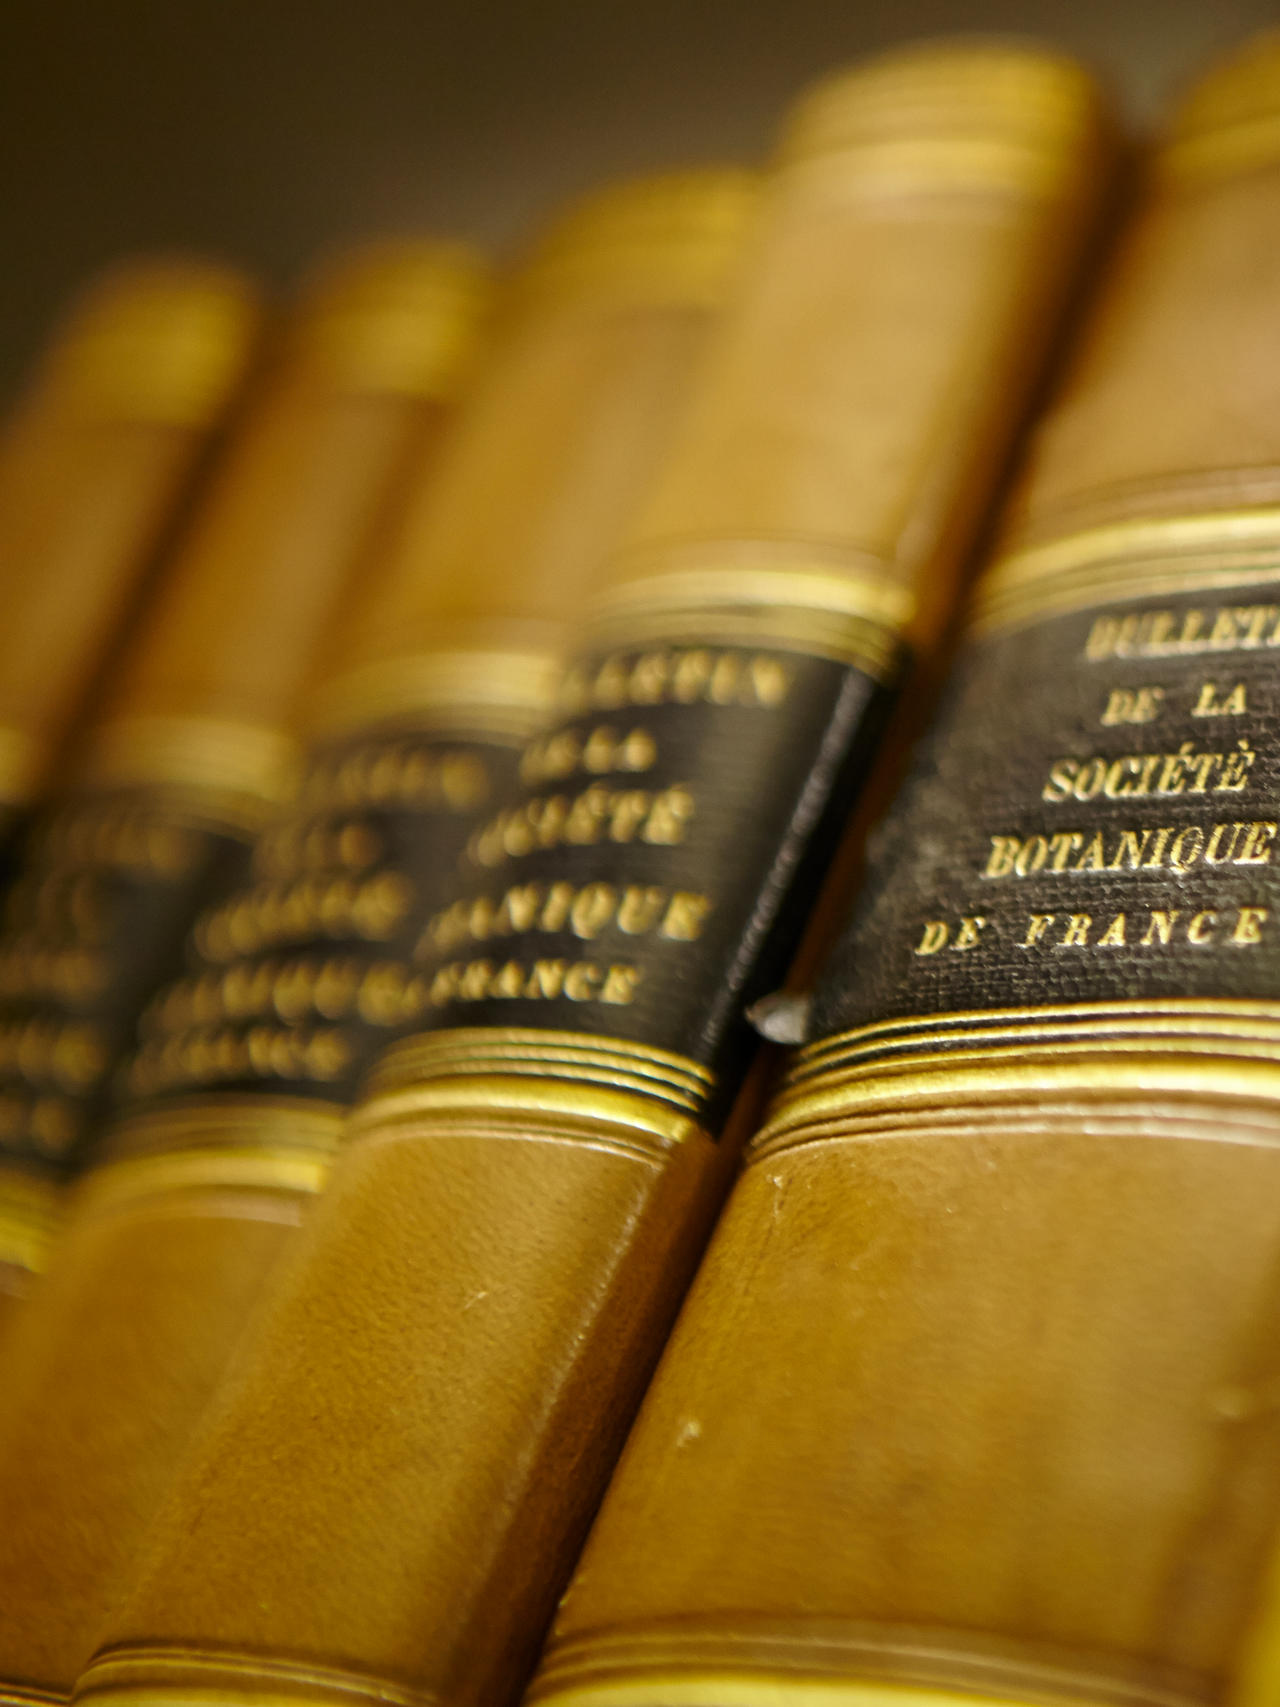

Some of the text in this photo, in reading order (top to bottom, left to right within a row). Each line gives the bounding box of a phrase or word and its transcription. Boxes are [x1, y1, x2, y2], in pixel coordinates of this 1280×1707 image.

[1102, 682, 1248, 726] DE LA
[979, 820, 1279, 881] BOTANIQUE
[914, 906, 1270, 957] DE FRANCE
